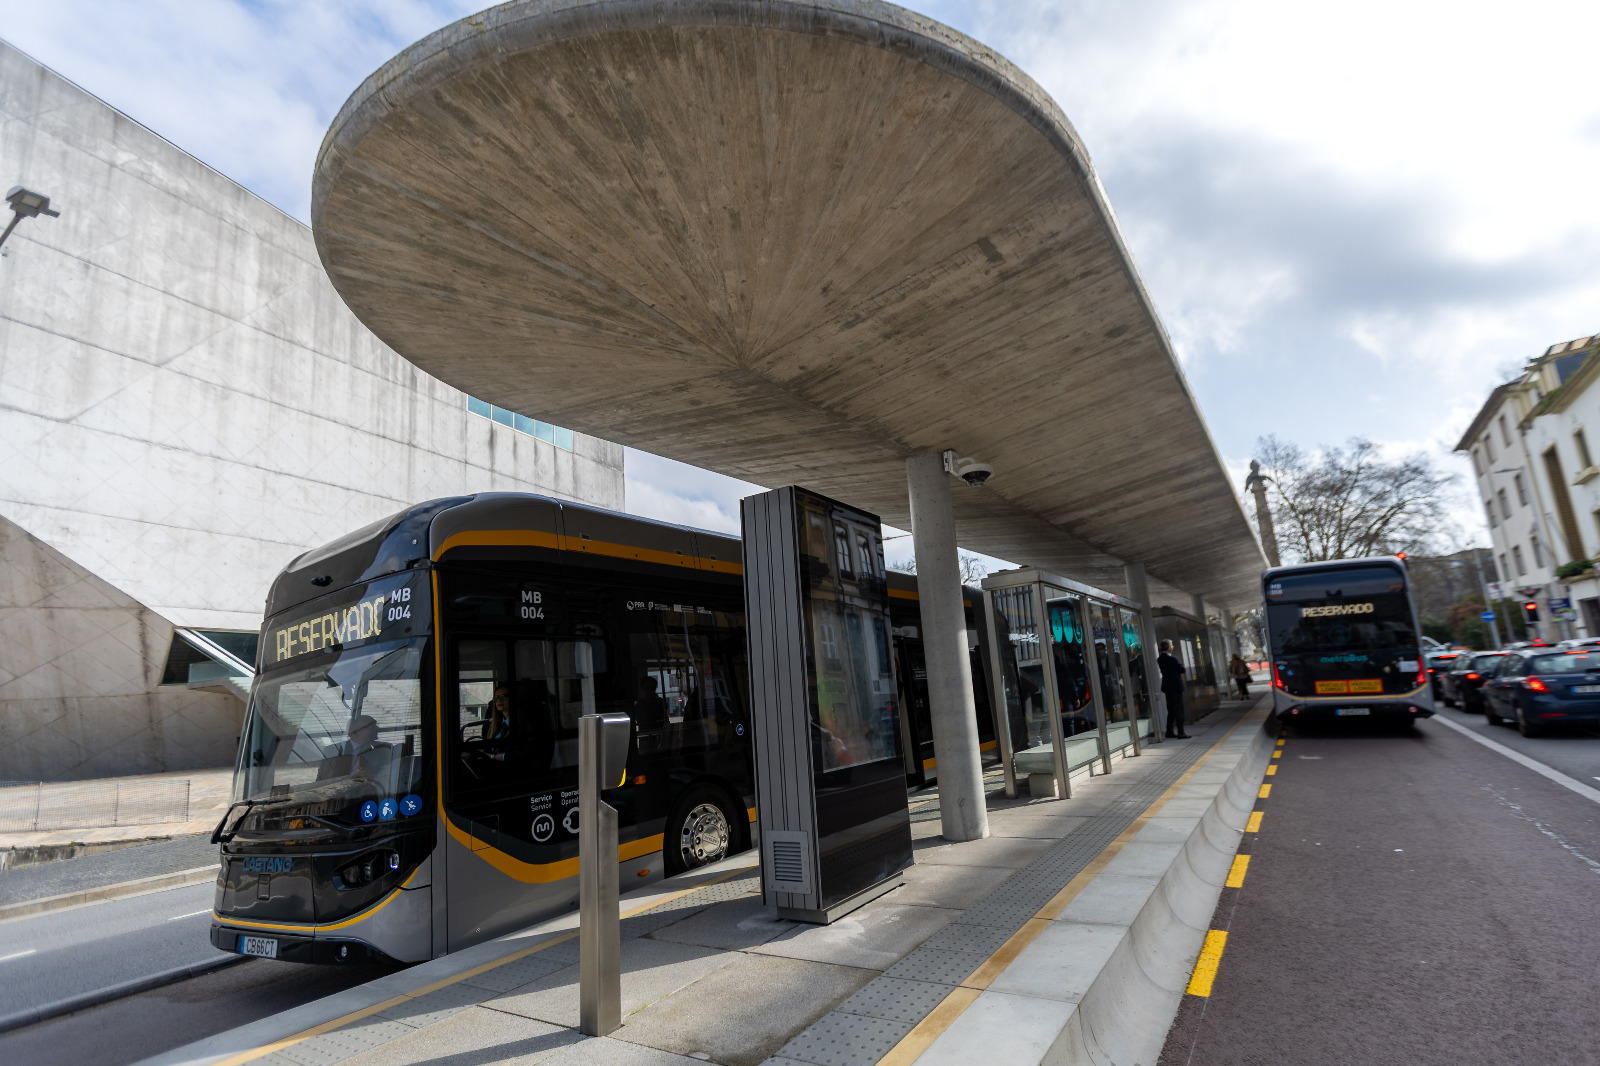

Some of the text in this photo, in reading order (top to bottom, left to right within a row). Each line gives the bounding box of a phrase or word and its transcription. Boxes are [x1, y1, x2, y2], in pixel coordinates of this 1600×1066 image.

[391, 588, 411, 603] MB
[521, 590, 542, 604] MB
[388, 604, 411, 622] 004
[521, 606, 545, 620] 004
[1301, 602, 1375, 618] RESERVADO
[530, 794, 552, 804] Serviço
[530, 802, 552, 812] Service
[243, 857, 293, 873] CAETANO
